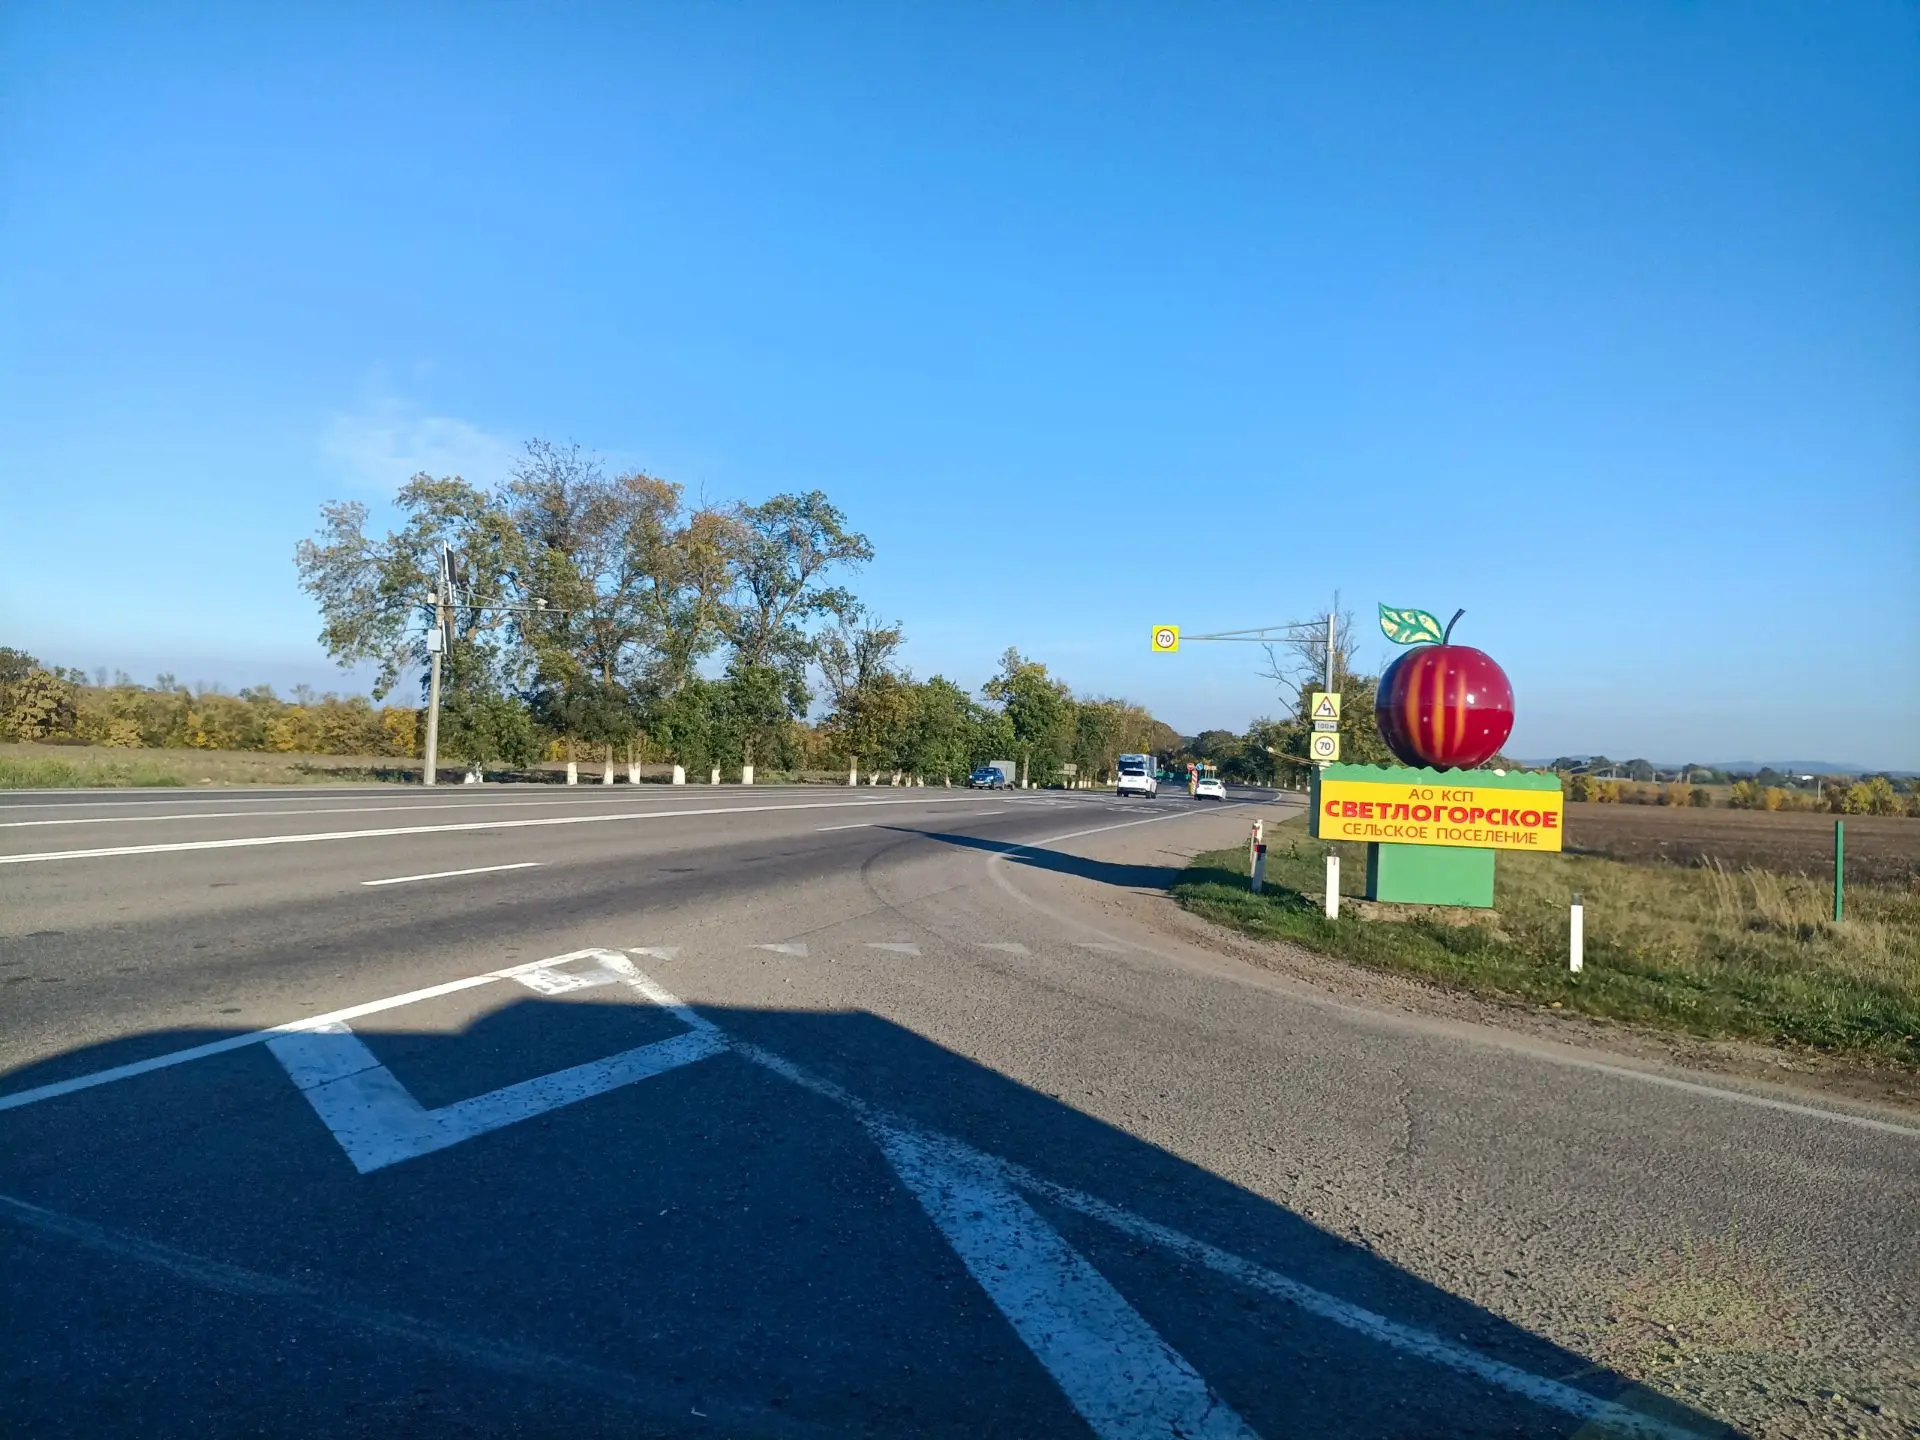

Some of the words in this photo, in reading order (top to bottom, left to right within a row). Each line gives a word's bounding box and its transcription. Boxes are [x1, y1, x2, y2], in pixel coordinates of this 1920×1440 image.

[1160, 634, 1171, 643] 70
[1319, 741, 1331, 751] 70
[1408, 788, 1434, 801] АО
[1442, 790, 1474, 802] КСП
[1324, 800, 1558, 828] СВЕТЛОГОРСКОЕ
[1342, 822, 1428, 839] СЕЛЬСКОЕ
[1436, 827, 1539, 845] ПОСЕЛЕНИЕ
